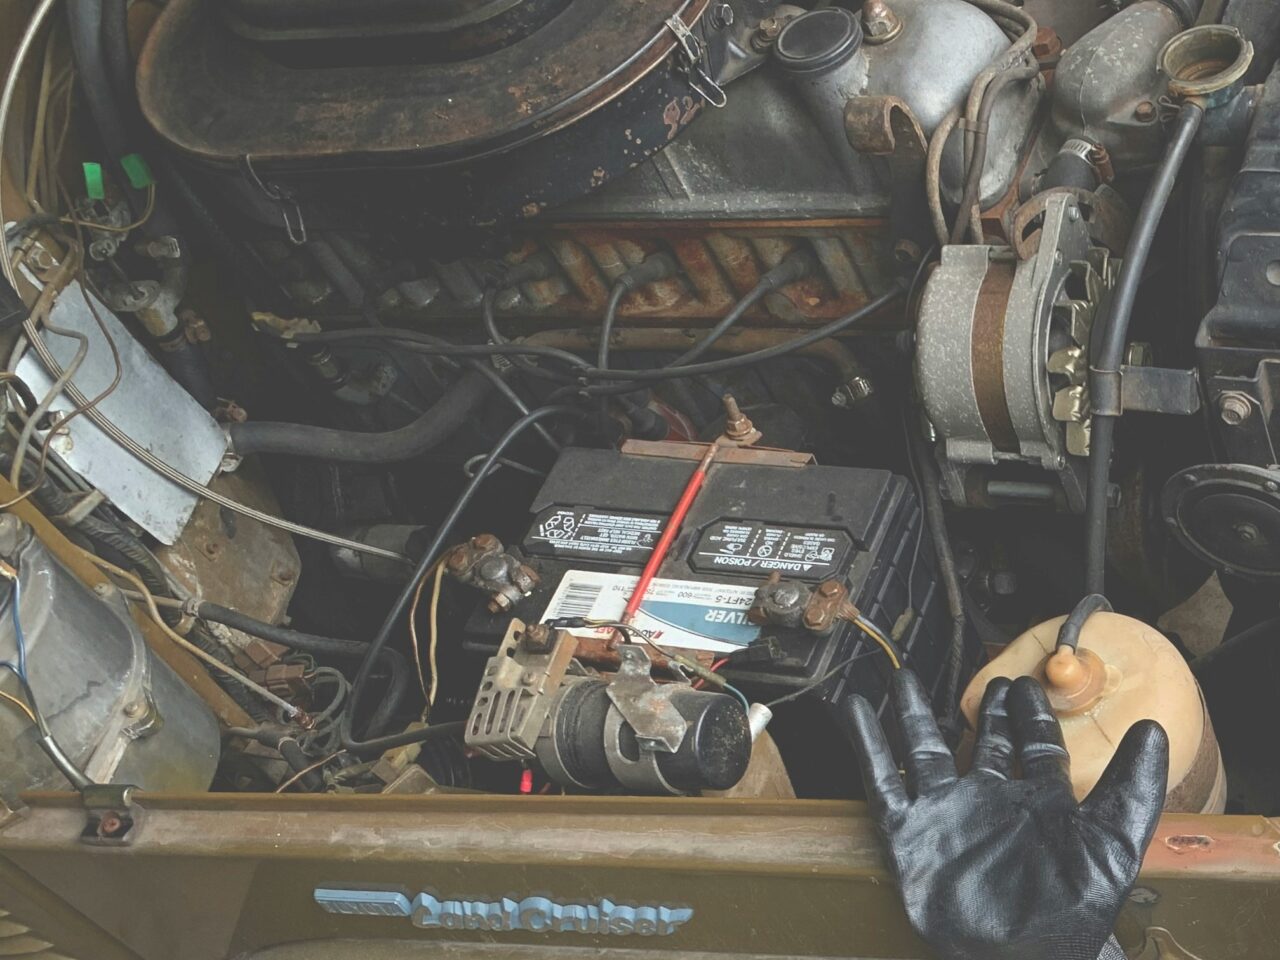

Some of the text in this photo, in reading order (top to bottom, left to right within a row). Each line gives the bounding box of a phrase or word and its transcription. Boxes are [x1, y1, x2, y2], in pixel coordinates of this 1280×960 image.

[714, 556, 752, 567] POISON
[760, 560, 801, 571] DANGER
[411, 895, 513, 931] Land
[519, 898, 694, 936] Cruiser
